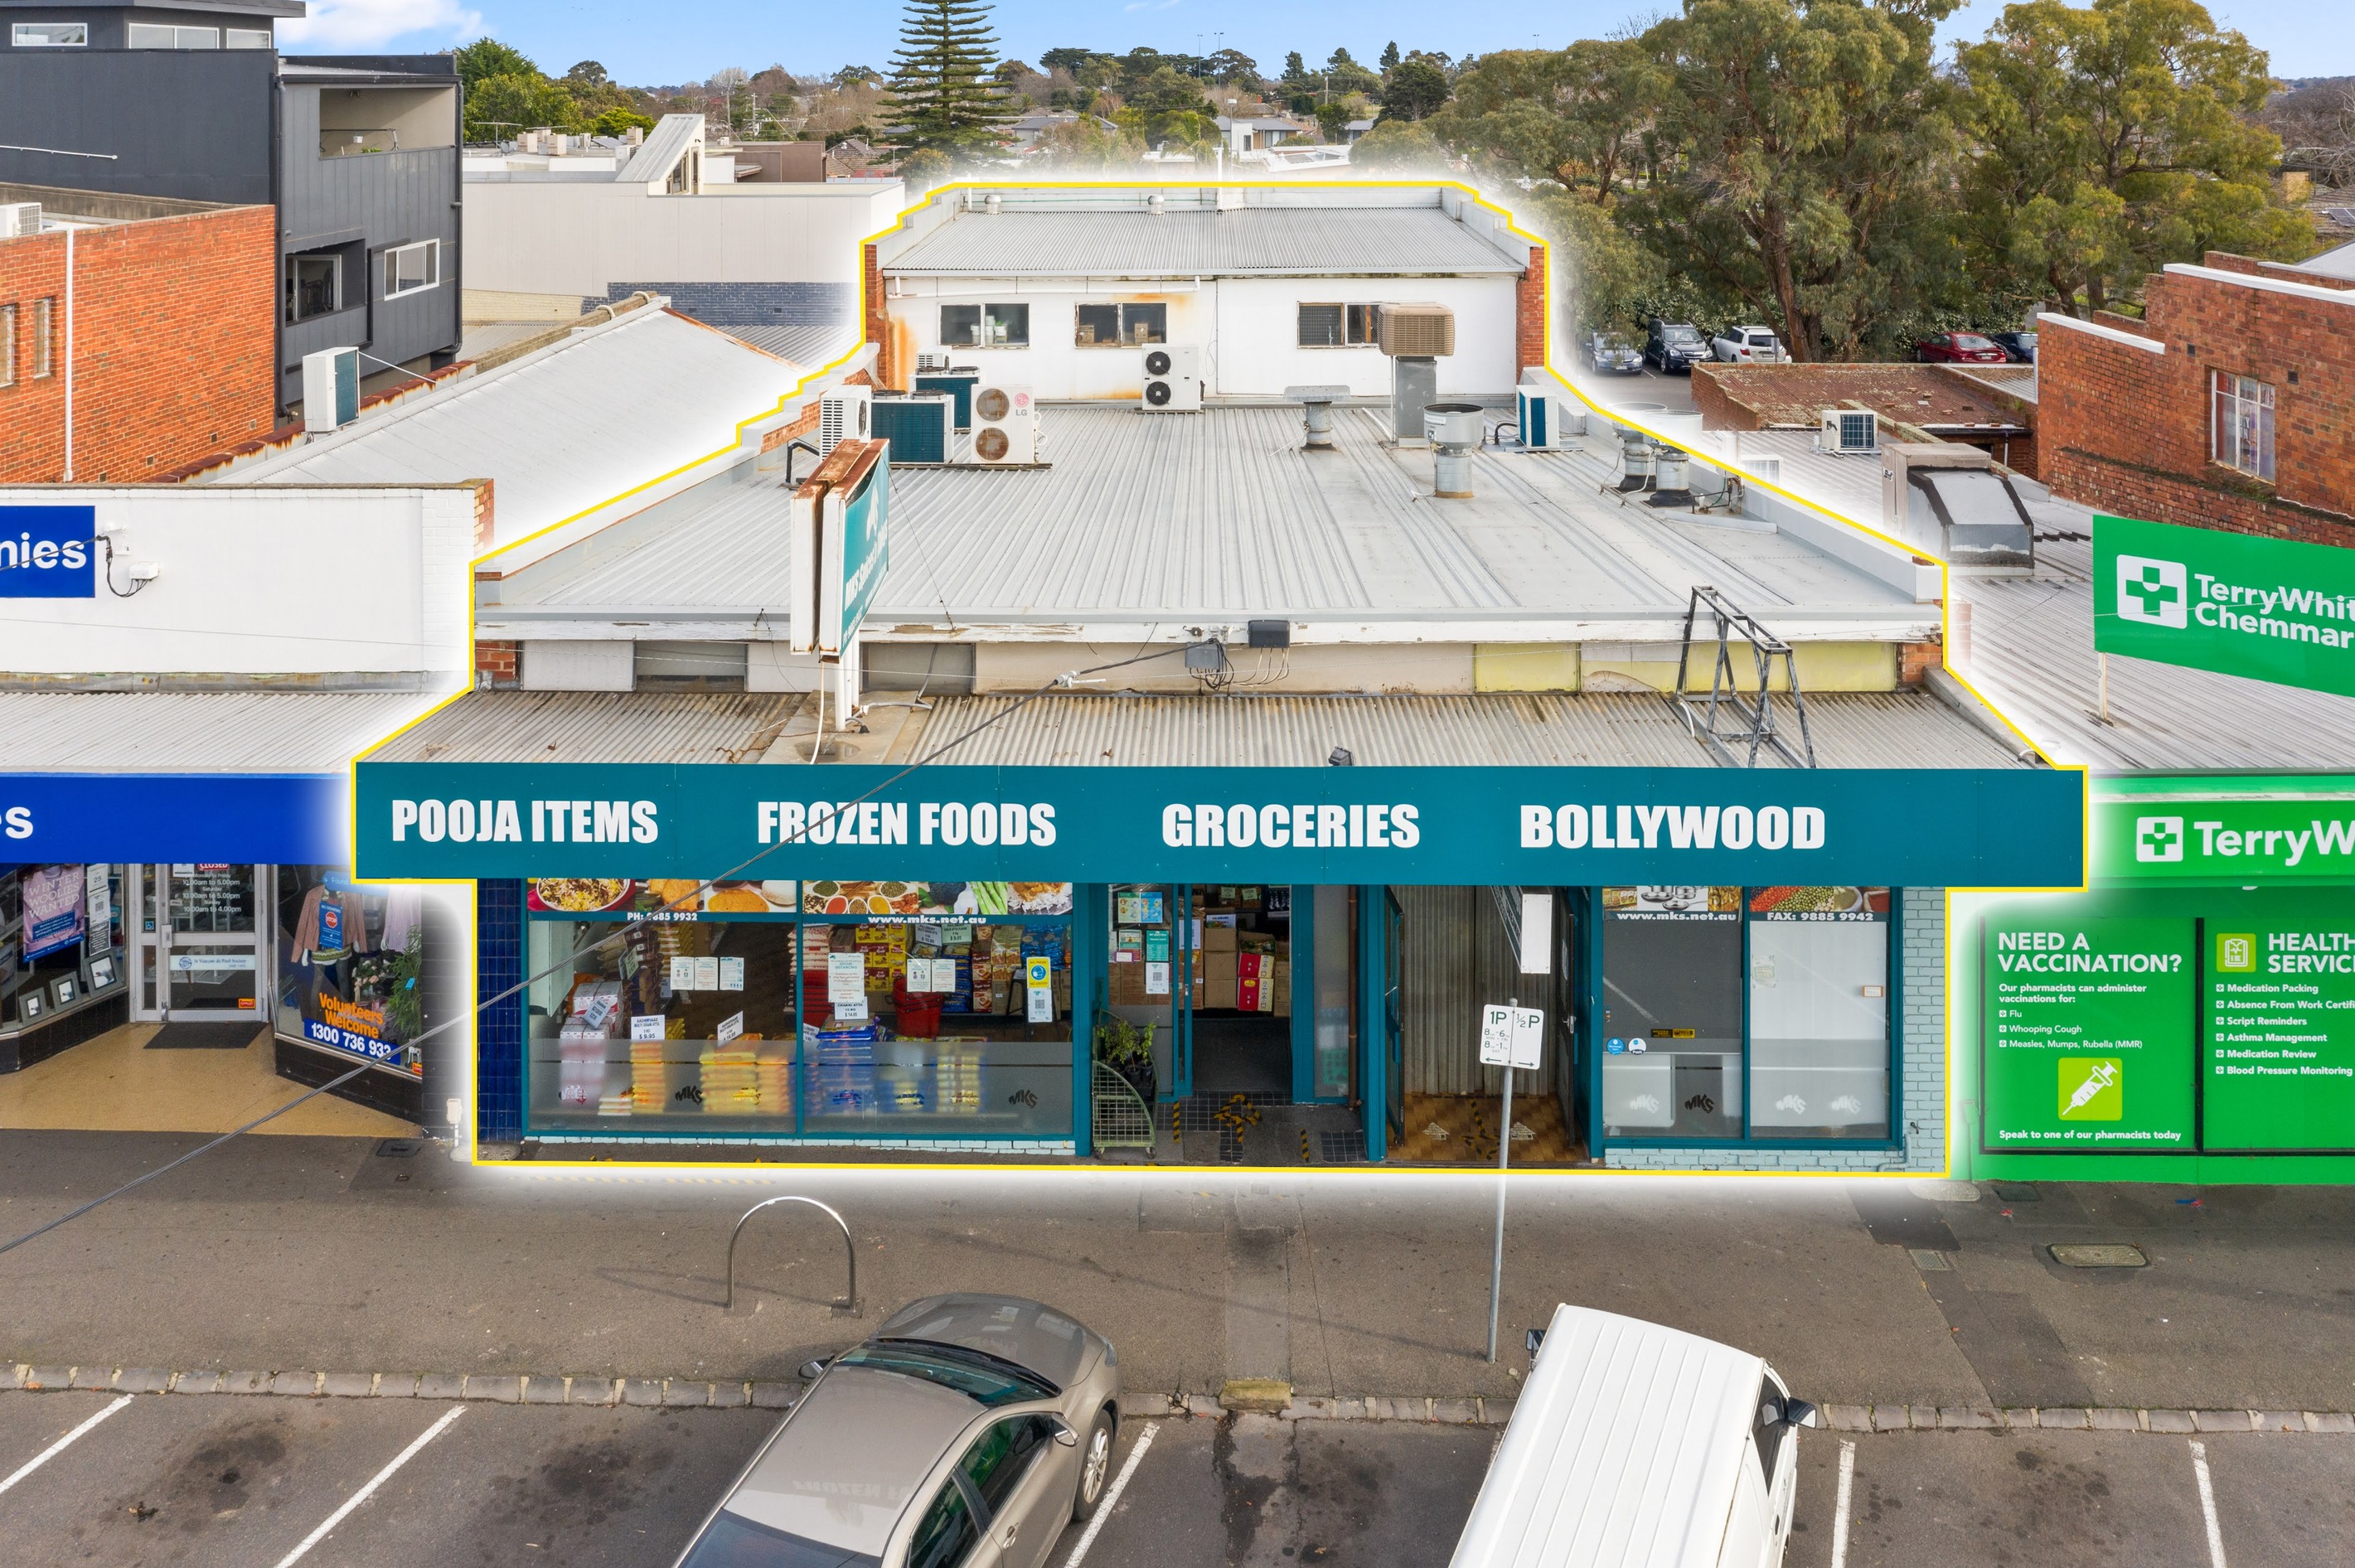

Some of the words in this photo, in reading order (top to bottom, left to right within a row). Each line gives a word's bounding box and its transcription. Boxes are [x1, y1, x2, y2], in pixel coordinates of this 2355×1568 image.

[0, 532, 86, 569] nies
[2194, 601, 2355, 649] Chemmar
[0, 806, 33, 839] s
[393, 800, 521, 842] POOJA
[532, 801, 657, 843] ITEMS
[758, 801, 907, 844] FROZEN
[920, 801, 1057, 847] FOODS
[1163, 804, 1419, 848] GROCERIES
[1521, 805, 1825, 849] BOLLYWOOD
[29, 872, 80, 896] WINTER
[29, 883, 80, 907] WOOLIES
[29, 894, 80, 918] WANTED
[627, 912, 643, 921] PH:
[673, 912, 697, 921] 9932
[867, 914, 986, 924] www.mks.net.au
[1616, 912, 1737, 922] www.mks.net.au
[1767, 912, 1796, 921] FAX:
[1800, 912, 1835, 921] 9885
[1839, 912, 1873, 921] 9942
[1999, 932, 2065, 951] NEED
[2072, 933, 2090, 951] A
[2268, 933, 2355, 951] HEALTH
[1998, 954, 2183, 973] VACCINATION?
[2268, 954, 2355, 973] SERVIC
[1999, 984, 2017, 993] Our
[2020, 984, 2076, 995] pharmacists
[2097, 984, 2147, 993] administer
[2227, 984, 2280, 993] Medication
[2283, 984, 2319, 995] Packing
[318, 992, 385, 1025] Volunteers
[1999, 995, 2056, 1004] vaccinations
[2058, 995, 2076, 1004] for:
[2227, 1000, 2267, 1009] Absence
[2270, 1000, 2294, 1009] From
[2297, 1000, 2323, 1009] Work
[1490, 1011, 1507, 1024] 1P
[2009, 1009, 2022, 1018] Flu
[2227, 1017, 2255, 1028] Script
[2257, 1017, 2307, 1026] Reminders
[325, 1009, 380, 1039] Welcome
[2009, 1025, 2052, 1036] Whooping
[2054, 1025, 2082, 1035] Cough
[311, 1022, 340, 1043] 1300
[342, 1032, 366, 1053] 736
[368, 1040, 392, 1060] 933
[2009, 1040, 2045, 1050] Measles,
[2047, 1040, 2081, 1050] Mumps,
[2083, 1040, 2113, 1049] Rubella
[2115, 1040, 2143, 1050] (MMR)
[2227, 1033, 2263, 1042] Asthma
[2265, 1033, 2327, 1044] Management
[2227, 1049, 2280, 1058] Medication
[2282, 1049, 2317, 1058] Review
[2227, 1066, 2255, 1075] Blood
[2257, 1066, 2298, 1075] Pressure
[2300, 1066, 2353, 1077] Monitoring
[675, 1086, 703, 1106] MKS
[1009, 1089, 1038, 1109] MKS
[1630, 1093, 1660, 1114] MKS
[1684, 1093, 1714, 1114] MKS
[1776, 1094, 1807, 1115] MKS
[1831, 1094, 1862, 1115] MKS
[1999, 1130, 2028, 1140] Speak
[2064, 1130, 2075, 1139] of
[2096, 1130, 2151, 1141] pharmacists
[2154, 1130, 2182, 1141] today
